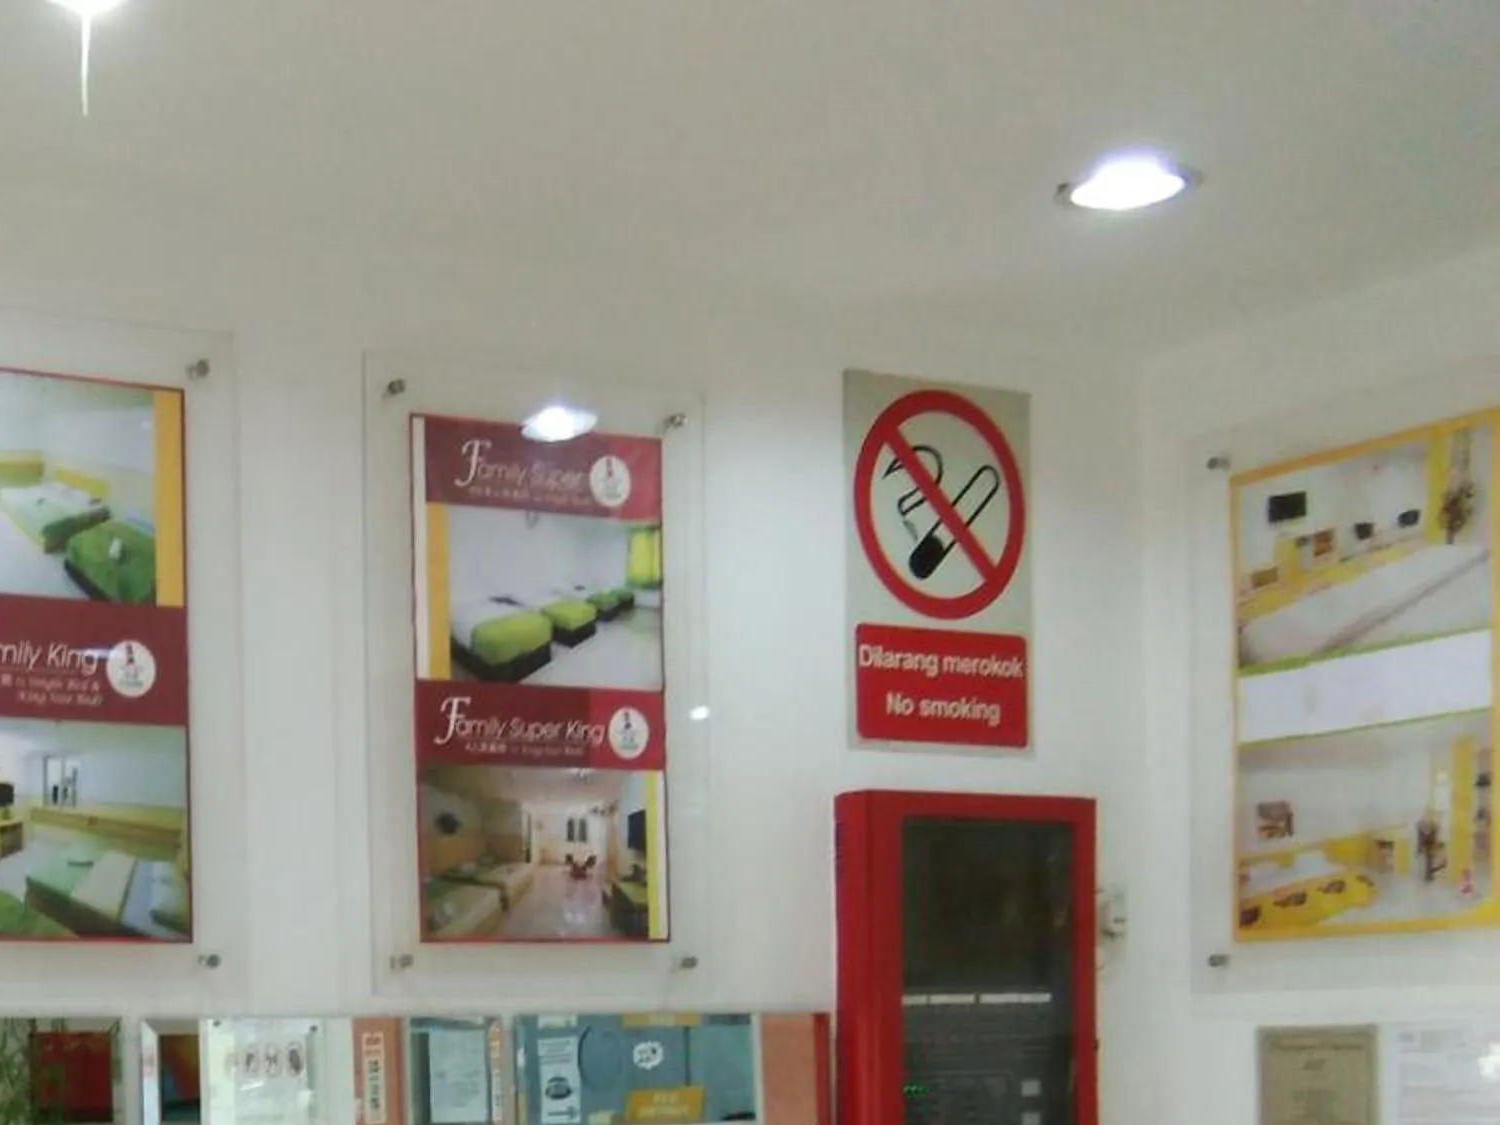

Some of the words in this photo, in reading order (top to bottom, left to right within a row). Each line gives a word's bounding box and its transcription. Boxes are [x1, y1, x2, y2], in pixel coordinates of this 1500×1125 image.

[47, 643, 99, 675] King
[858, 644, 940, 678] Dilarang
[942, 654, 1024, 678] merokok
[433, 696, 508, 745] Family
[508, 717, 562, 743] Super
[565, 719, 606, 746] King
[886, 691, 915, 716] No
[918, 697, 1001, 727] smoking
